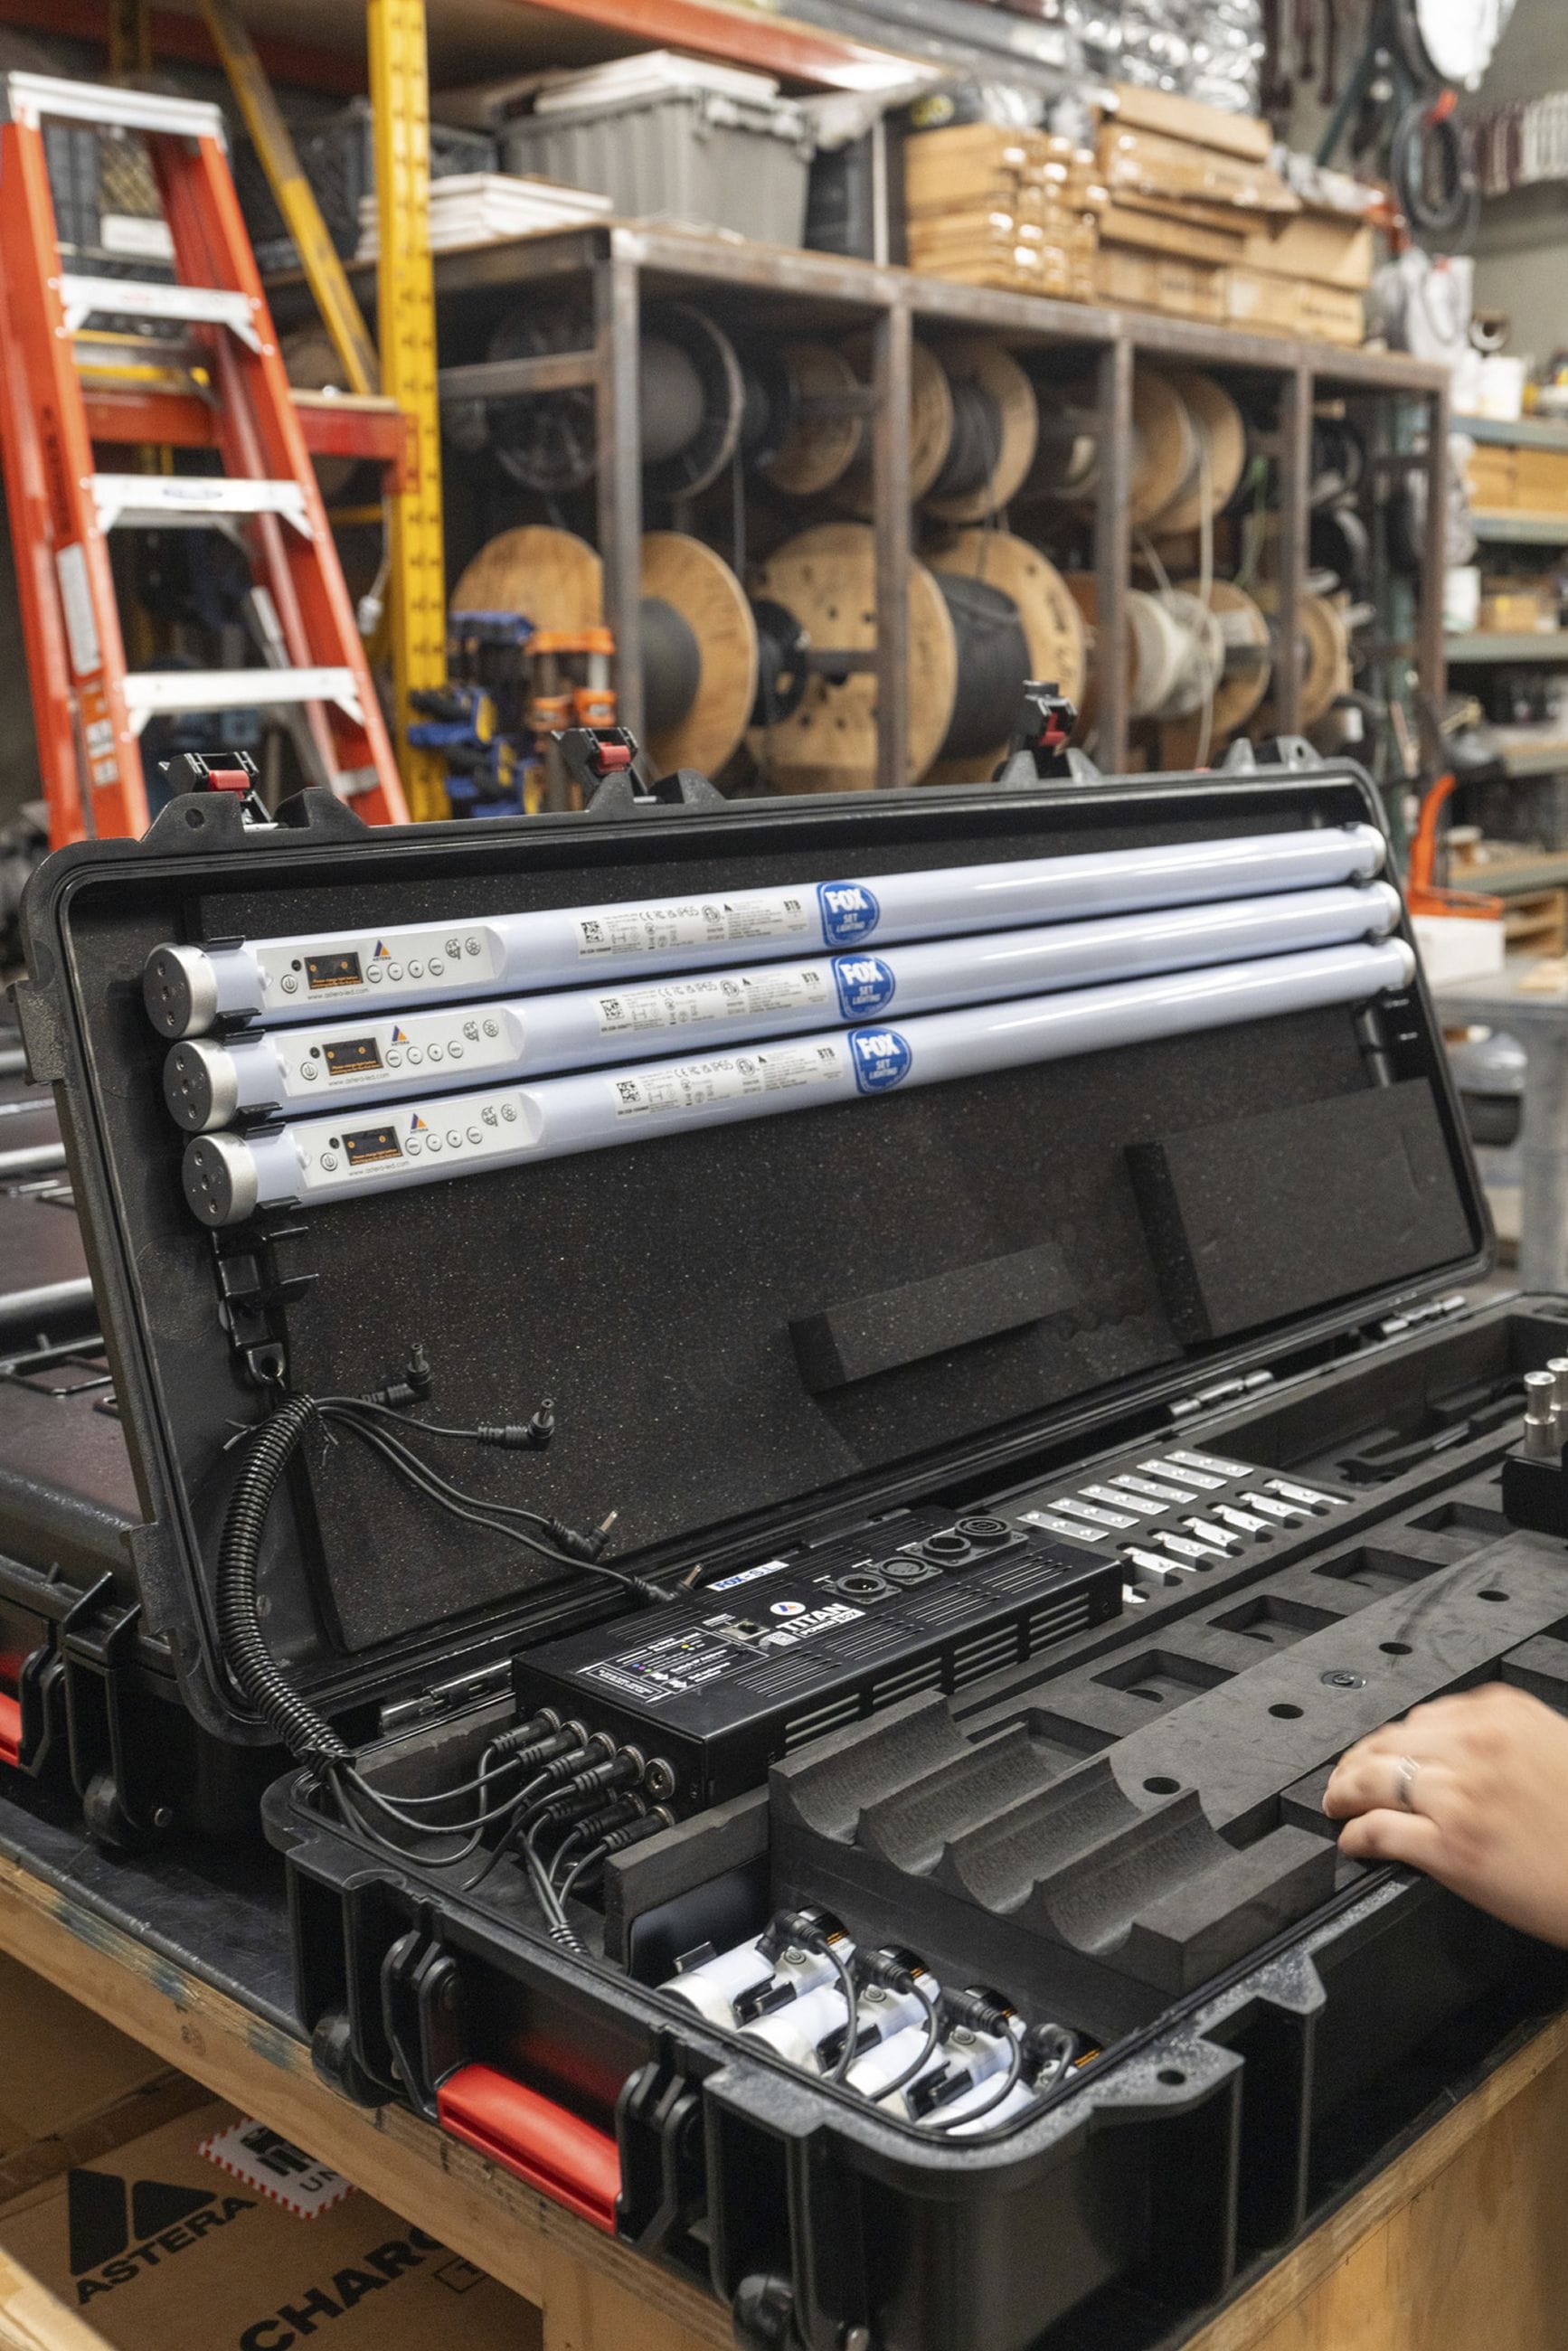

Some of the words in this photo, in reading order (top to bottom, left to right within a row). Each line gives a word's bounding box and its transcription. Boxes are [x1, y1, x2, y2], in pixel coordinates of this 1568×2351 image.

[825, 889, 868, 913] FOX
[839, 961, 883, 986] FOX
[856, 1034, 900, 1060] FOX
[776, 1603, 851, 1631] TITAN
[77, 2197, 258, 2305] ASTERA
